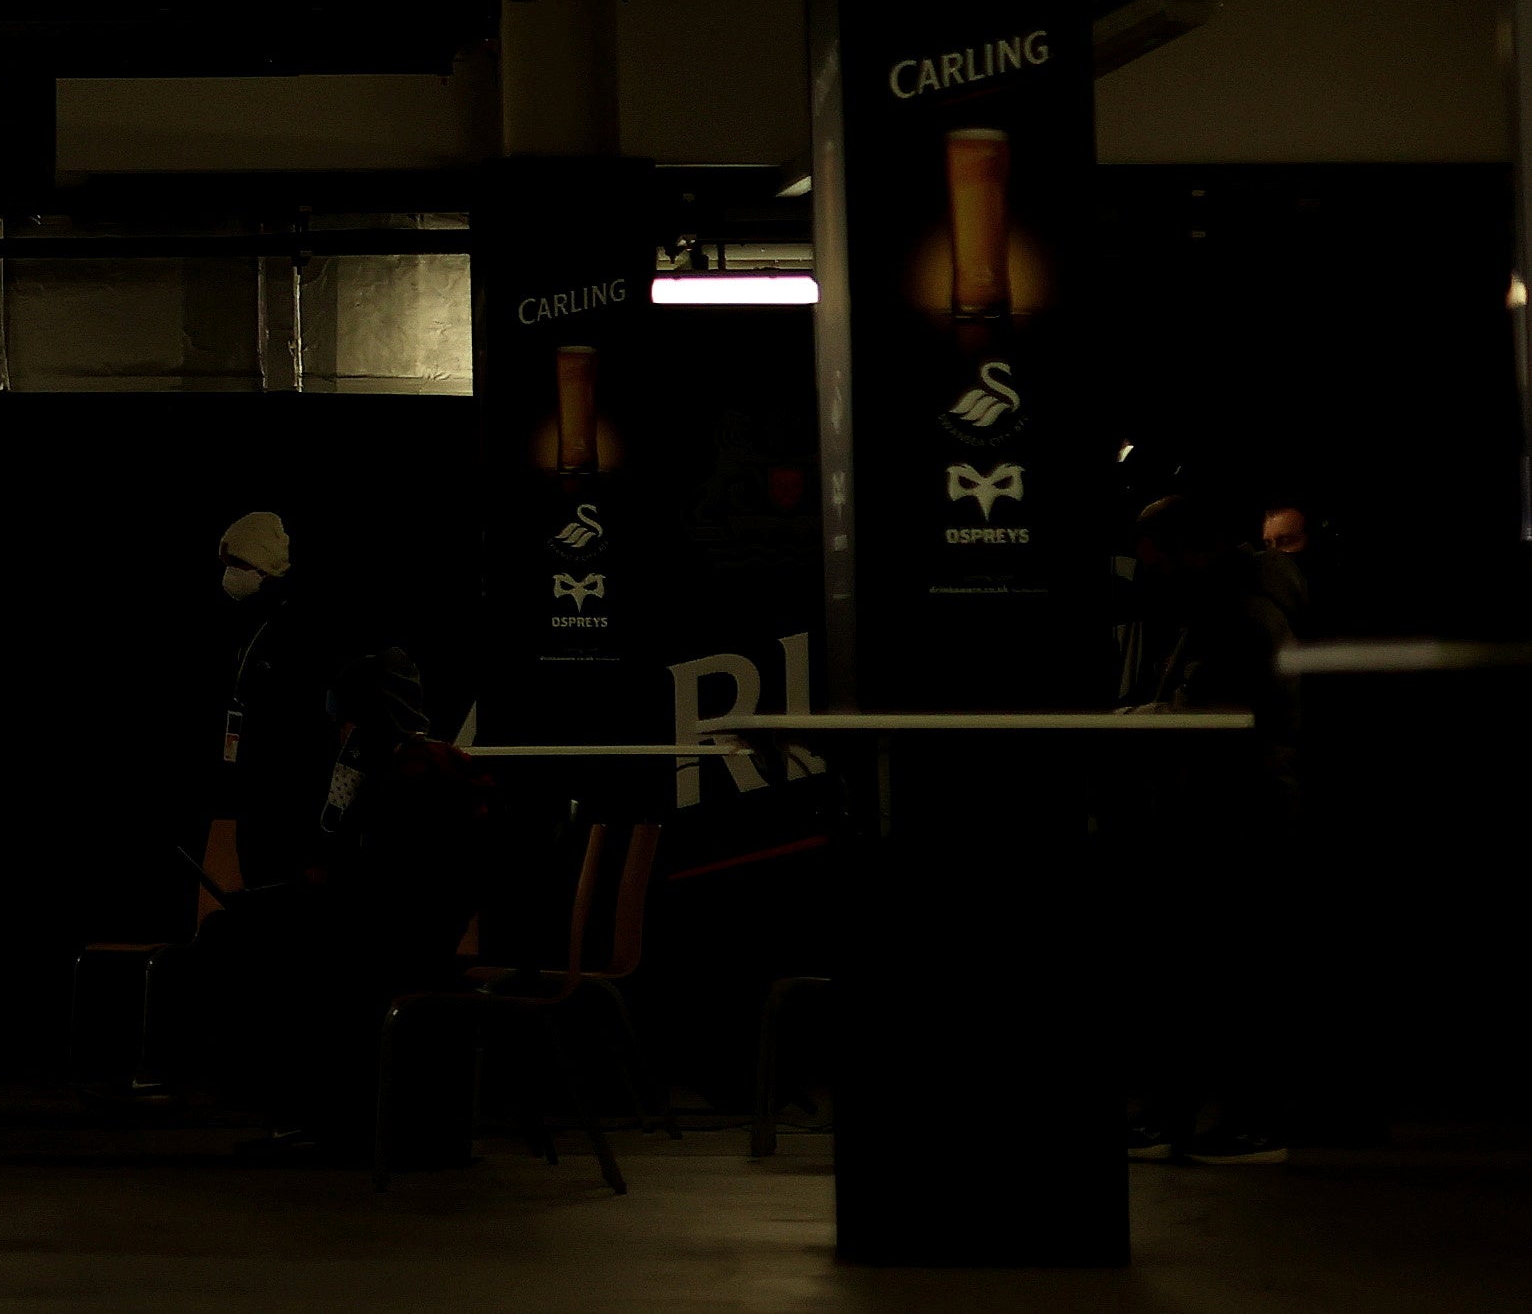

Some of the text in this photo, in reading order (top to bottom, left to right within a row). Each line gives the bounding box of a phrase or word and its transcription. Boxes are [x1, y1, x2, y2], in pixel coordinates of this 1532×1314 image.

[888, 29, 1050, 100] CARLING
[517, 277, 627, 326] CARLING
[944, 527, 1031, 546] OSPREYS
[551, 615, 609, 629] OSPREYS
